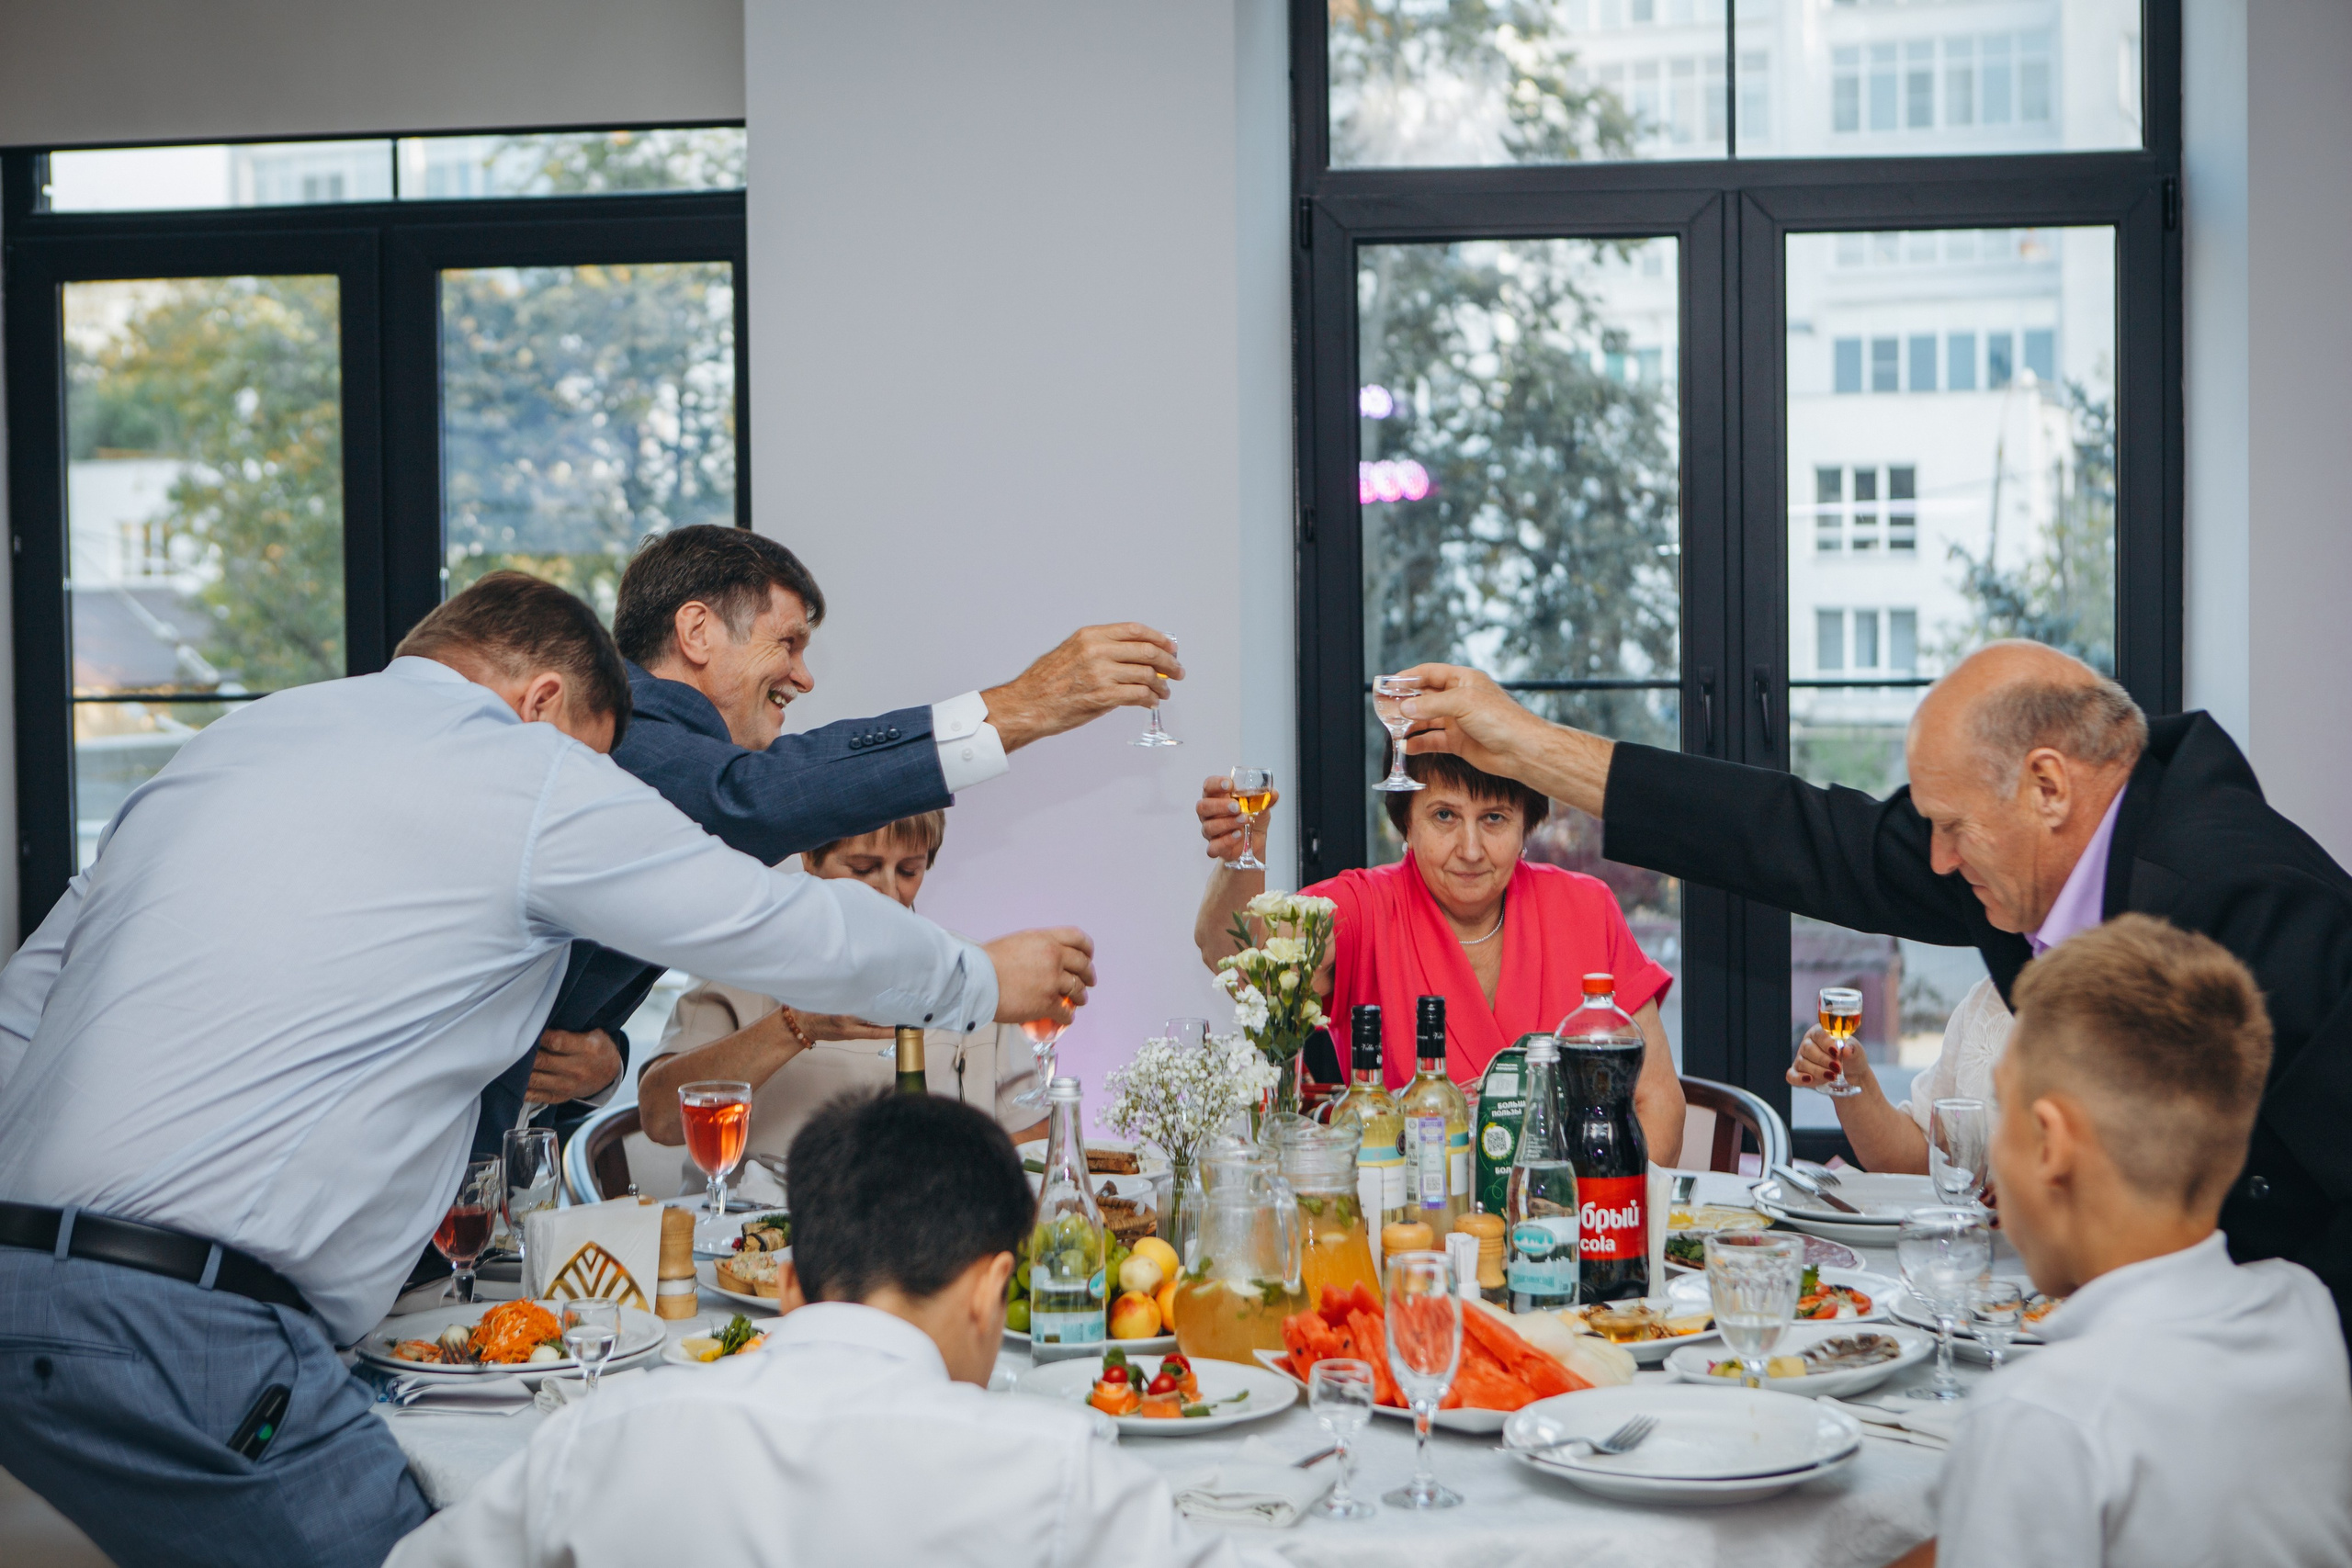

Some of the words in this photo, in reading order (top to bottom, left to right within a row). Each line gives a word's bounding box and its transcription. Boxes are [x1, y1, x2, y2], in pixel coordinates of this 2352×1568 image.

[1498, 1100, 1526, 1110] БОЛЬШ
[1491, 1108, 1522, 1118] ПОЛЬЗЫ
[1495, 1166, 1512, 1175] БОЛ
[1580, 1199, 1640, 1235] брый
[1579, 1235, 1616, 1252] cola
